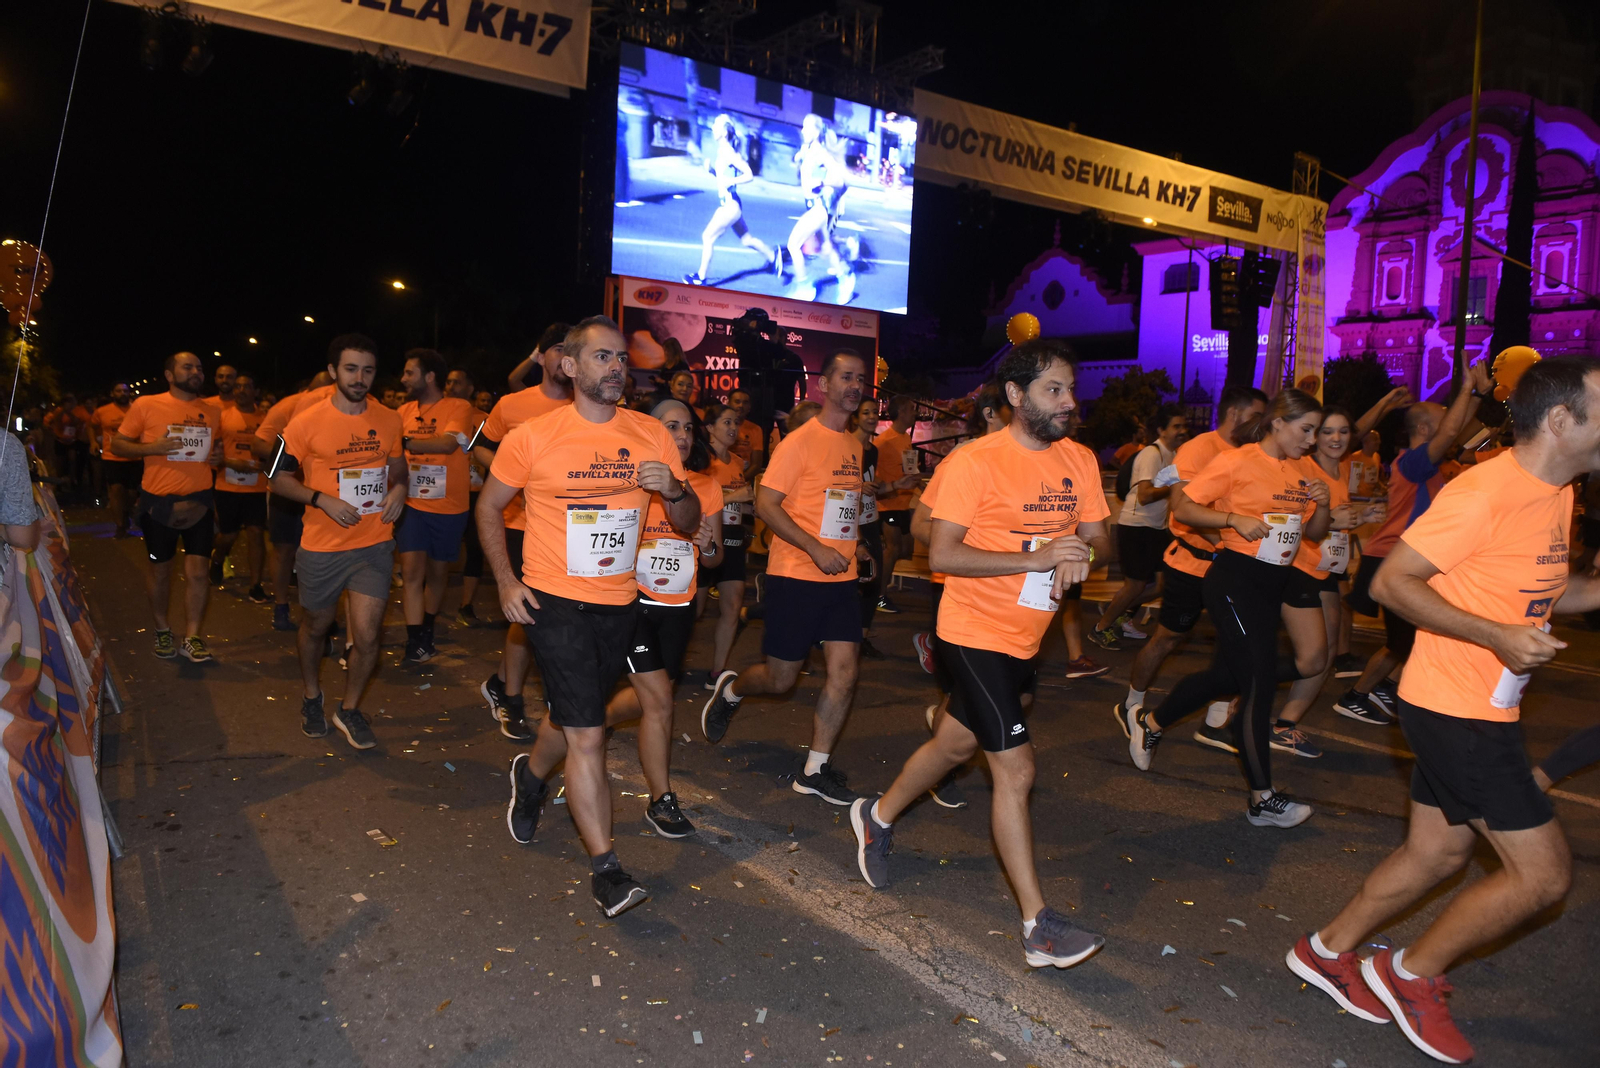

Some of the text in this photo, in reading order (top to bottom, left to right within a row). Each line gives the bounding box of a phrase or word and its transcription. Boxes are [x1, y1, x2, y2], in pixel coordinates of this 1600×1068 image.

[920, 116, 1055, 176] NOCTURNA
[1061, 155, 1150, 199] SEVILLA
[698, 299, 729, 309] Cruzcampo
[336, 447, 363, 455] SEVILLA
[416, 475, 436, 486] 5794
[567, 471, 610, 479] SEVILLA
[353, 482, 384, 496] 15746
[1038, 494, 1077, 502] NOCTURNA
[1023, 503, 1055, 512] SEVILLA
[590, 532, 625, 549] 7754
[1328, 545, 1345, 557] 19577
[650, 556, 680, 571] 7755
